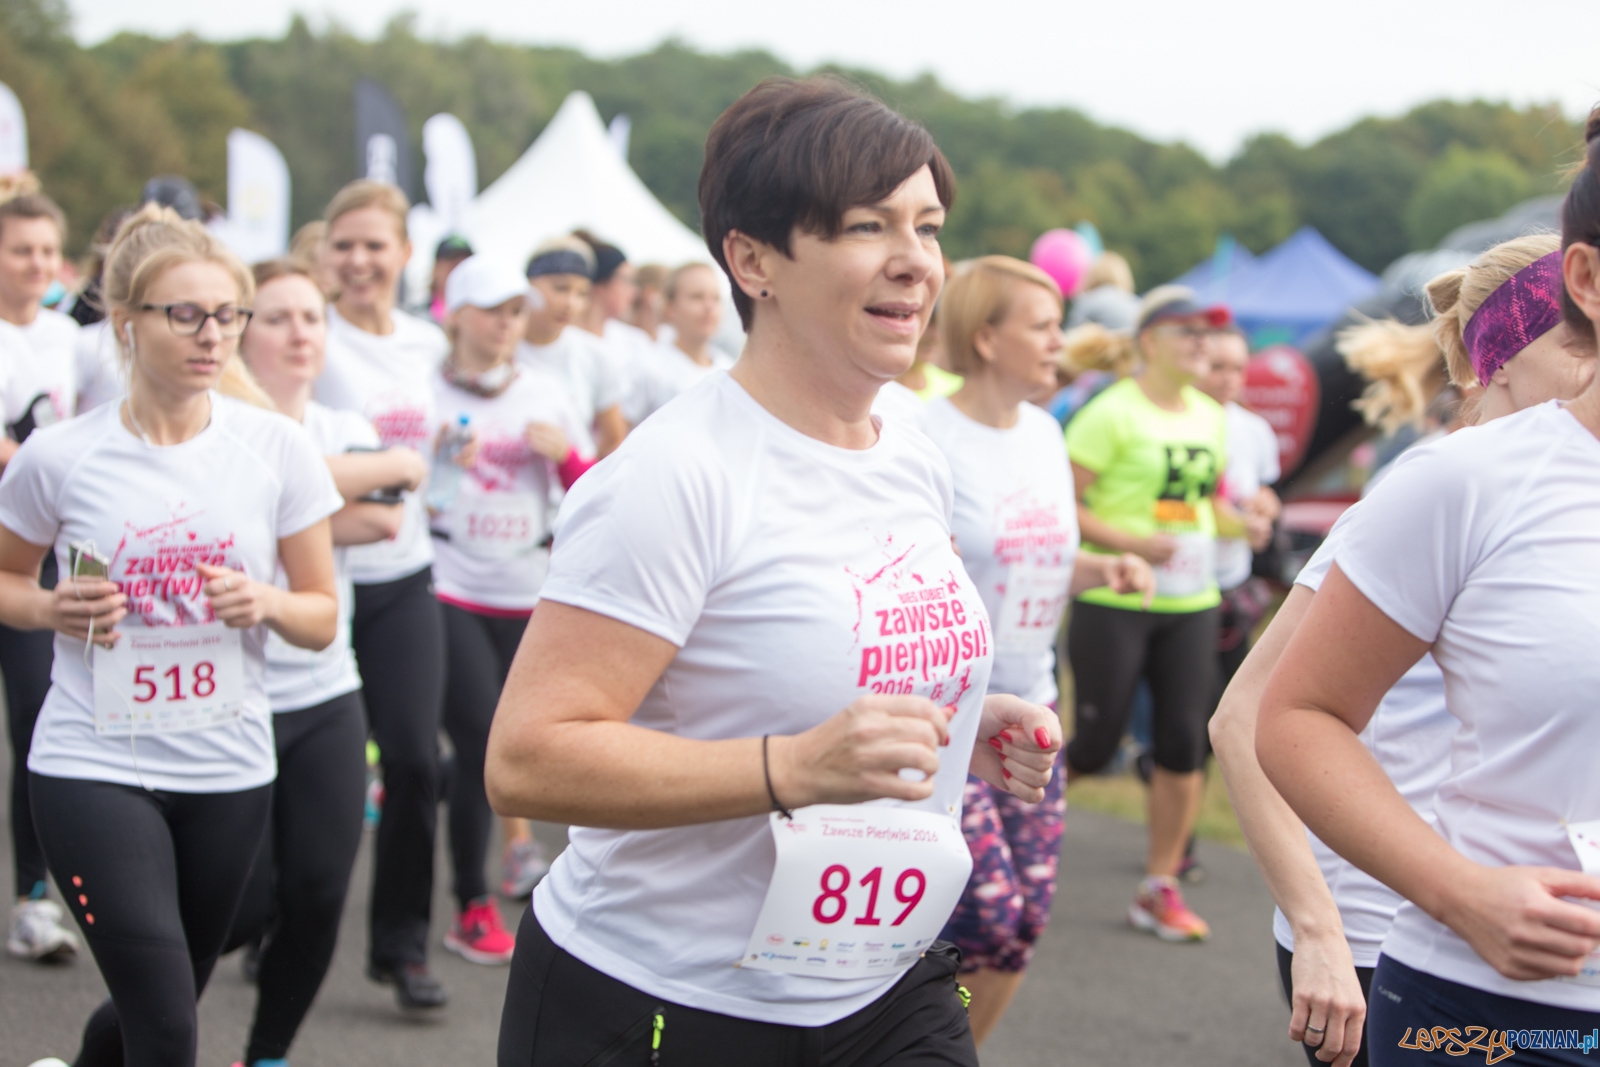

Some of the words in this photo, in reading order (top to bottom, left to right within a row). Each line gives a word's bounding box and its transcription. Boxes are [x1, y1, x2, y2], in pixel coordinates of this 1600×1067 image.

[467, 513, 529, 539] 1023
[898, 591, 918, 604] BIEG
[919, 587, 945, 601] KOBIET
[875, 599, 967, 637] zawsze
[132, 660, 217, 703] 518
[822, 824, 864, 838] Zawsze
[912, 829, 939, 843] 2016
[811, 864, 927, 927] 819
